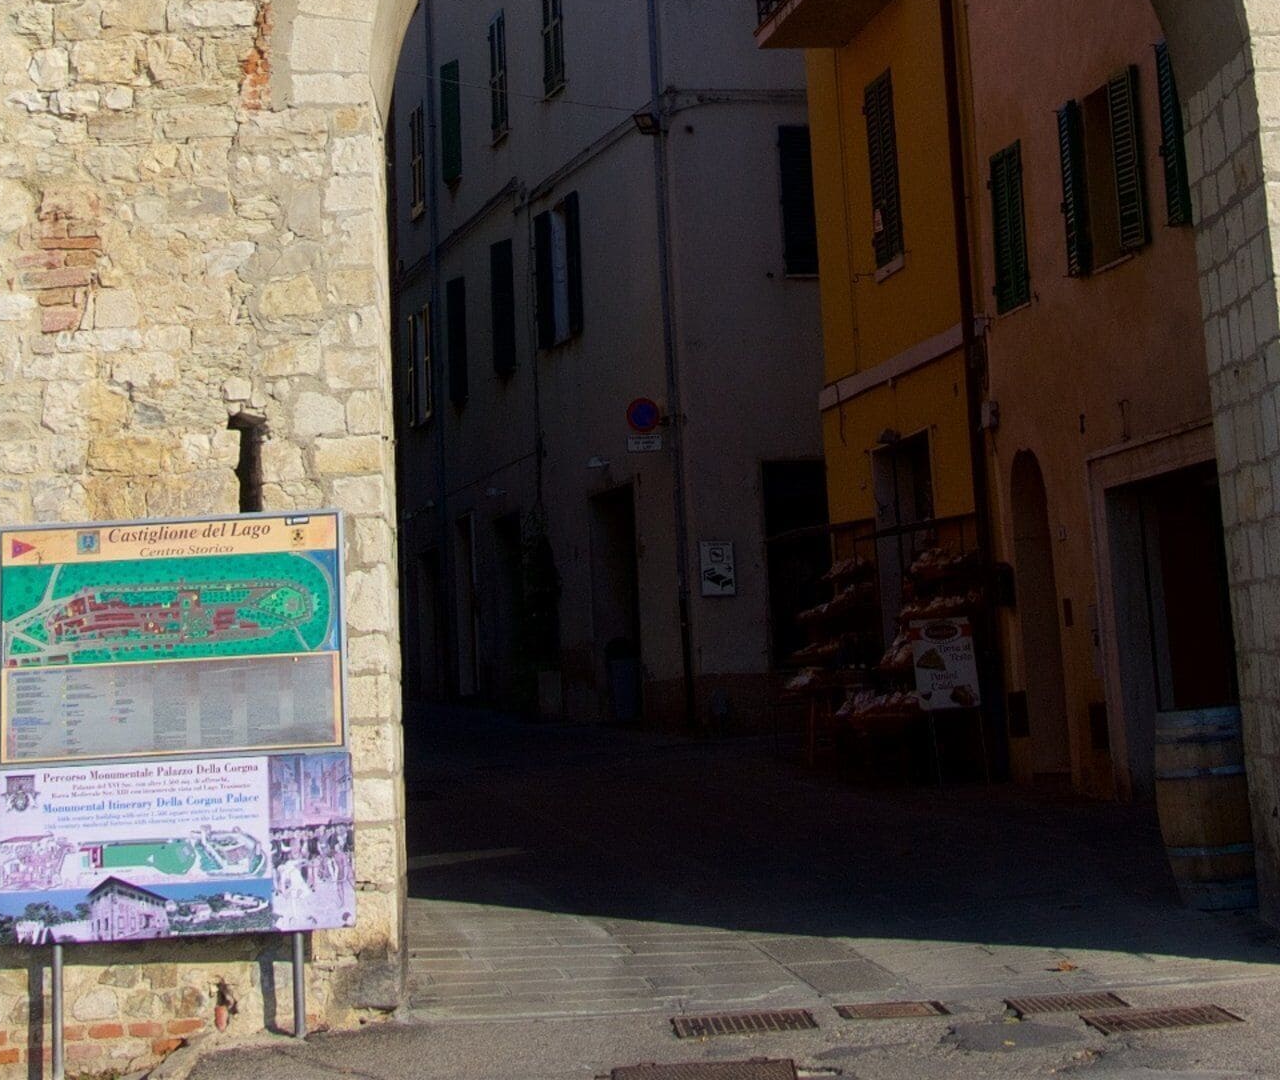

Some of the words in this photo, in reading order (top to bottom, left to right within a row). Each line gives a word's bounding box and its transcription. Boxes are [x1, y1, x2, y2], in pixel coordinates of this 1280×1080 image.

[109, 526, 197, 544] Castiglione
[202, 523, 225, 537] del
[231, 522, 270, 539] Lago
[140, 547, 184, 557] Centro
[188, 544, 233, 554] Storico
[43, 772, 86, 783] Percorso
[90, 768, 152, 780] Monumentale
[156, 766, 192, 776] Palazzo
[196, 764, 220, 774] Della
[224, 763, 258, 773] Corgna
[43, 800, 104, 813] Monumental
[108, 799, 151, 810] Itinerary
[156, 796, 182, 807] Della
[186, 795, 222, 806] Corgna
[226, 792, 258, 802] Palace
